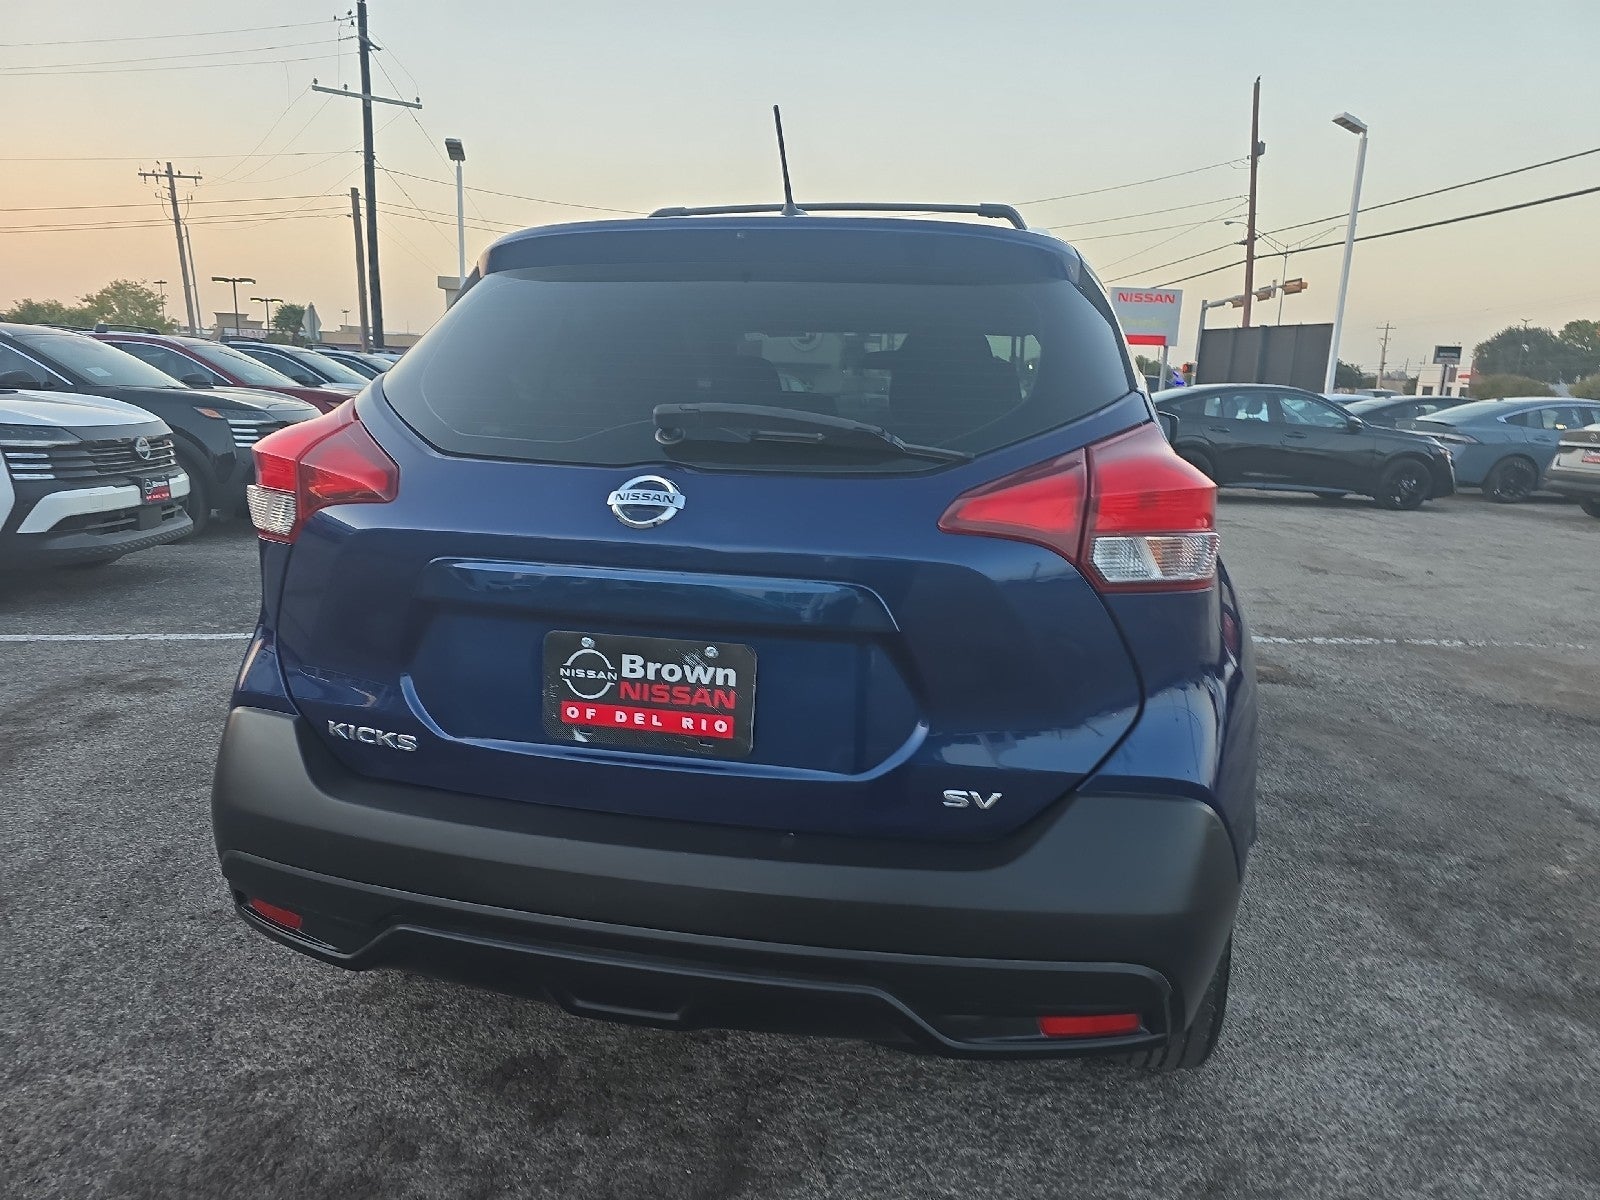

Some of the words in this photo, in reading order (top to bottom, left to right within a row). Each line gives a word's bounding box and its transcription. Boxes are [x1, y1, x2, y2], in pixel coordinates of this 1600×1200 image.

[1117, 292, 1176, 304] NISSAN
[615, 492, 676, 504] NISSAN
[560, 667, 618, 681] NISSAN
[621, 653, 736, 687] Brown
[619, 681, 736, 710] NISSAN
[566, 706, 597, 720] OF
[615, 710, 663, 727] DEL
[681, 716, 728, 733] RIO
[327, 719, 418, 752] KICKS
[942, 789, 1003, 810] SV
